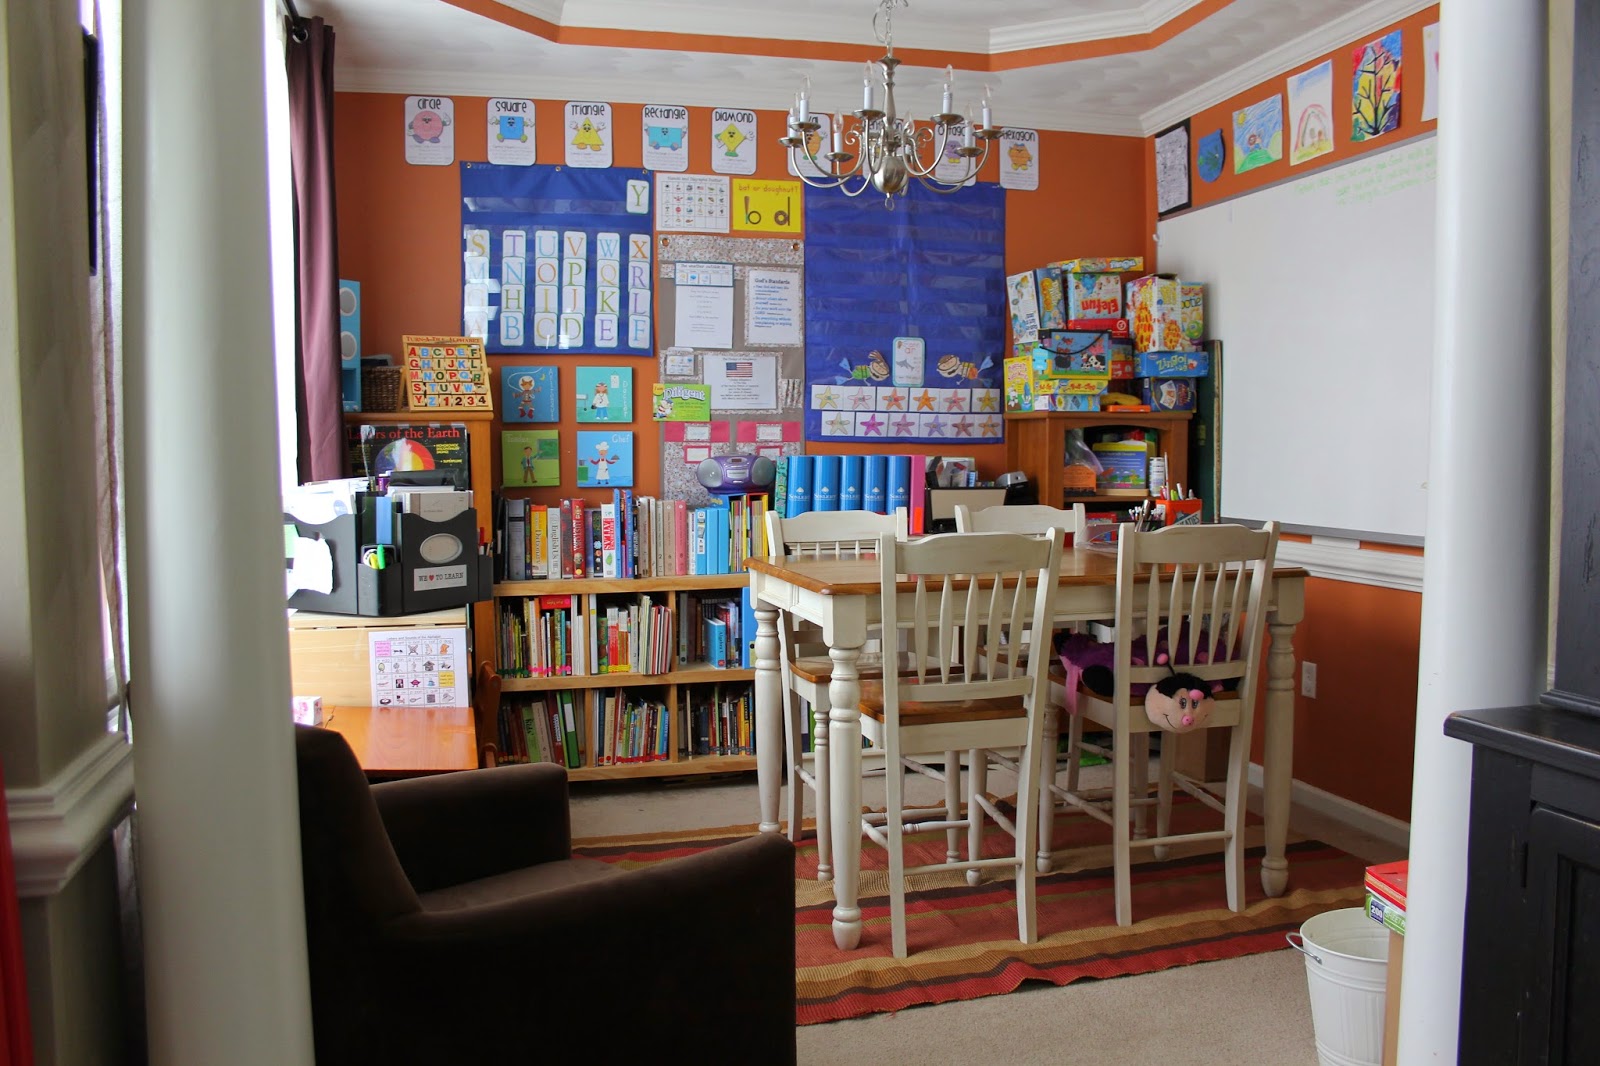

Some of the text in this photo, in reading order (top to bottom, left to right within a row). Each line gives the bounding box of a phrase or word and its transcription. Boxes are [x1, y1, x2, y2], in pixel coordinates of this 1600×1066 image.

[631, 185, 646, 206] Y
[472, 234, 648, 259] S T U V W X
[505, 262, 523, 284] N
[538, 263, 556, 283] O
[568, 263, 582, 286] P
[601, 264, 617, 285] Q
[632, 266, 646, 287] R
[505, 289, 522, 310] H
[571, 289, 578, 312] J
[600, 291, 616, 312] K
[633, 293, 646, 314] L
[504, 316, 520, 340] B
[536, 318, 554, 339] C
[564, 318, 581, 339] D
[600, 319, 614, 341] E
[634, 320, 646, 341] F
[409, 347, 416, 356] A
[421, 348, 428, 356] B
[433, 348, 442, 357] C
[410, 360, 419, 368] G
[422, 360, 430, 368] H
[448, 360, 454, 368] J
[471, 360, 477, 368] L
[424, 372, 432, 380] N
[436, 372, 444, 380] O
[414, 384, 421, 392] S
[430, 384, 436, 392] T
[440, 384, 448, 392] U
[453, 384, 460, 392] V
[428, 397, 436, 406] Z
[455, 397, 462, 406] 2
[467, 397, 474, 405] 3
[349, 428, 460, 439] Lars of the Earth
[612, 434, 630, 443] Chef
[551, 525, 559, 549] English
[1371, 905, 1382, 918] 200
